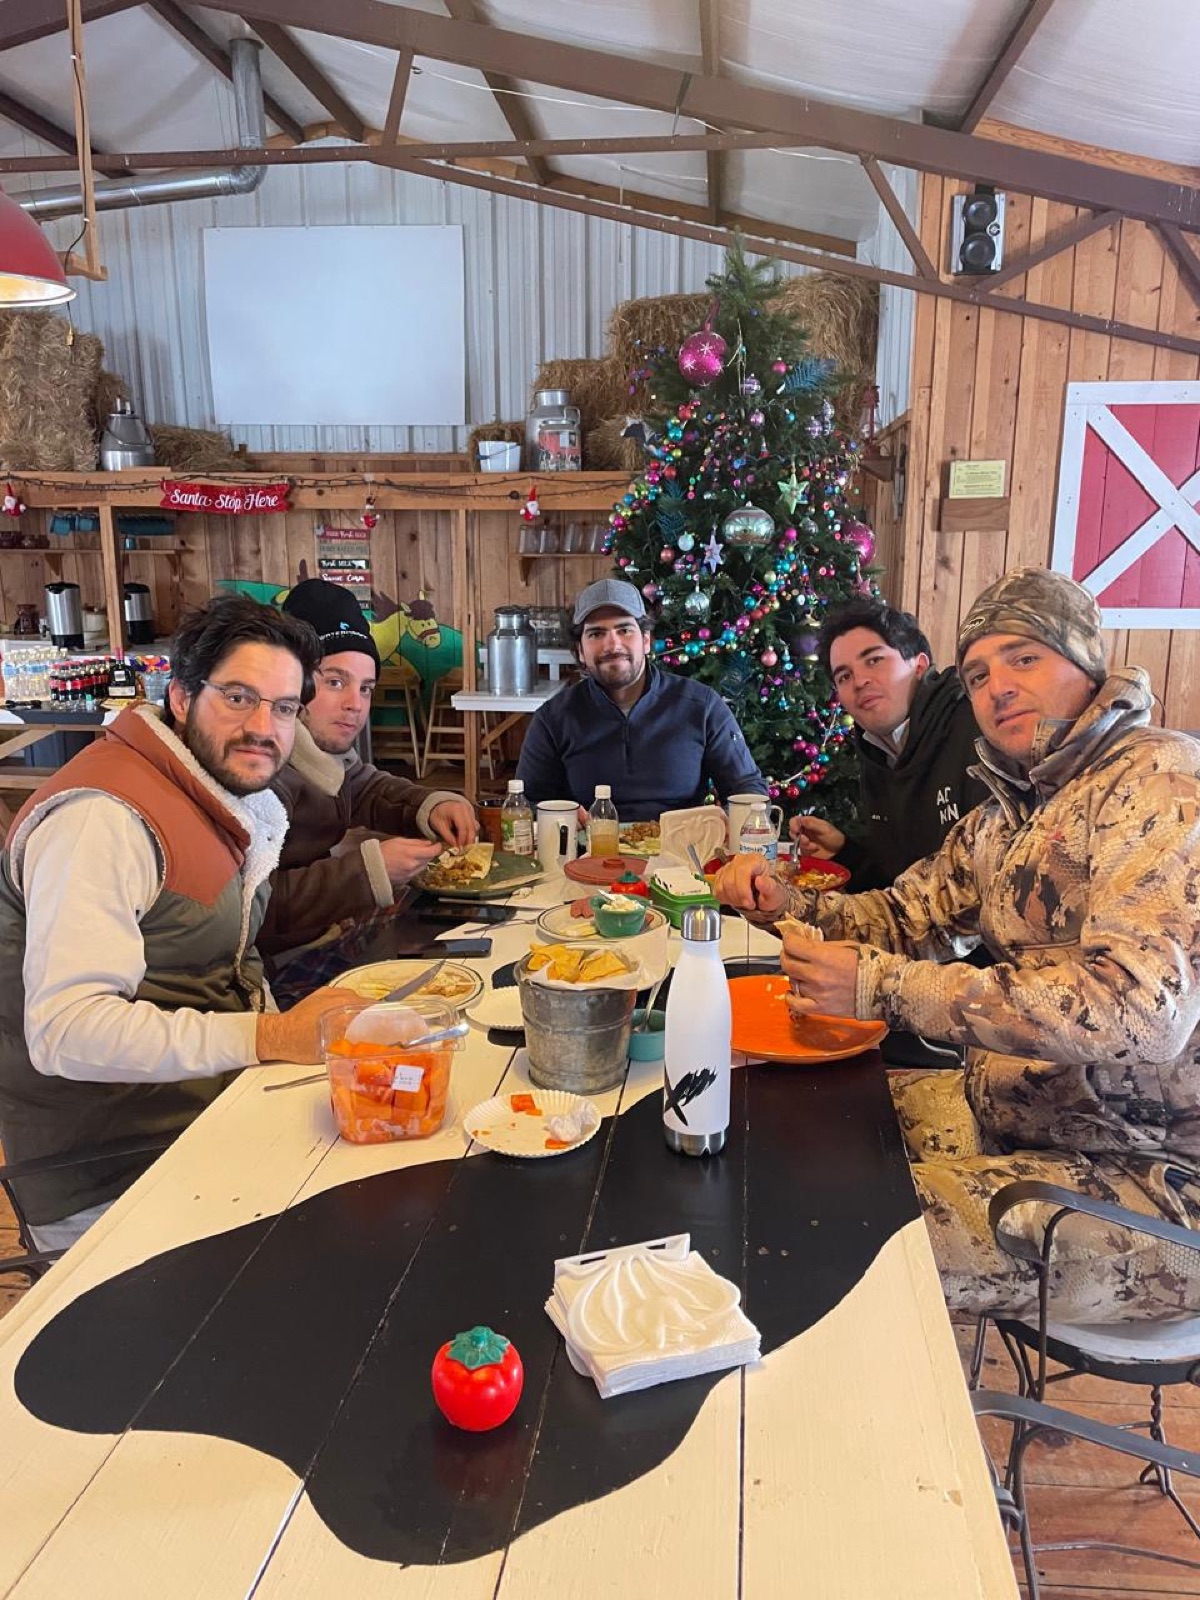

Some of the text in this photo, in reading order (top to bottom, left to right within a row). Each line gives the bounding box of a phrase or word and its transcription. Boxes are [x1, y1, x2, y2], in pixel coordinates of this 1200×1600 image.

[170, 488, 279, 513] Santa Stop Here
